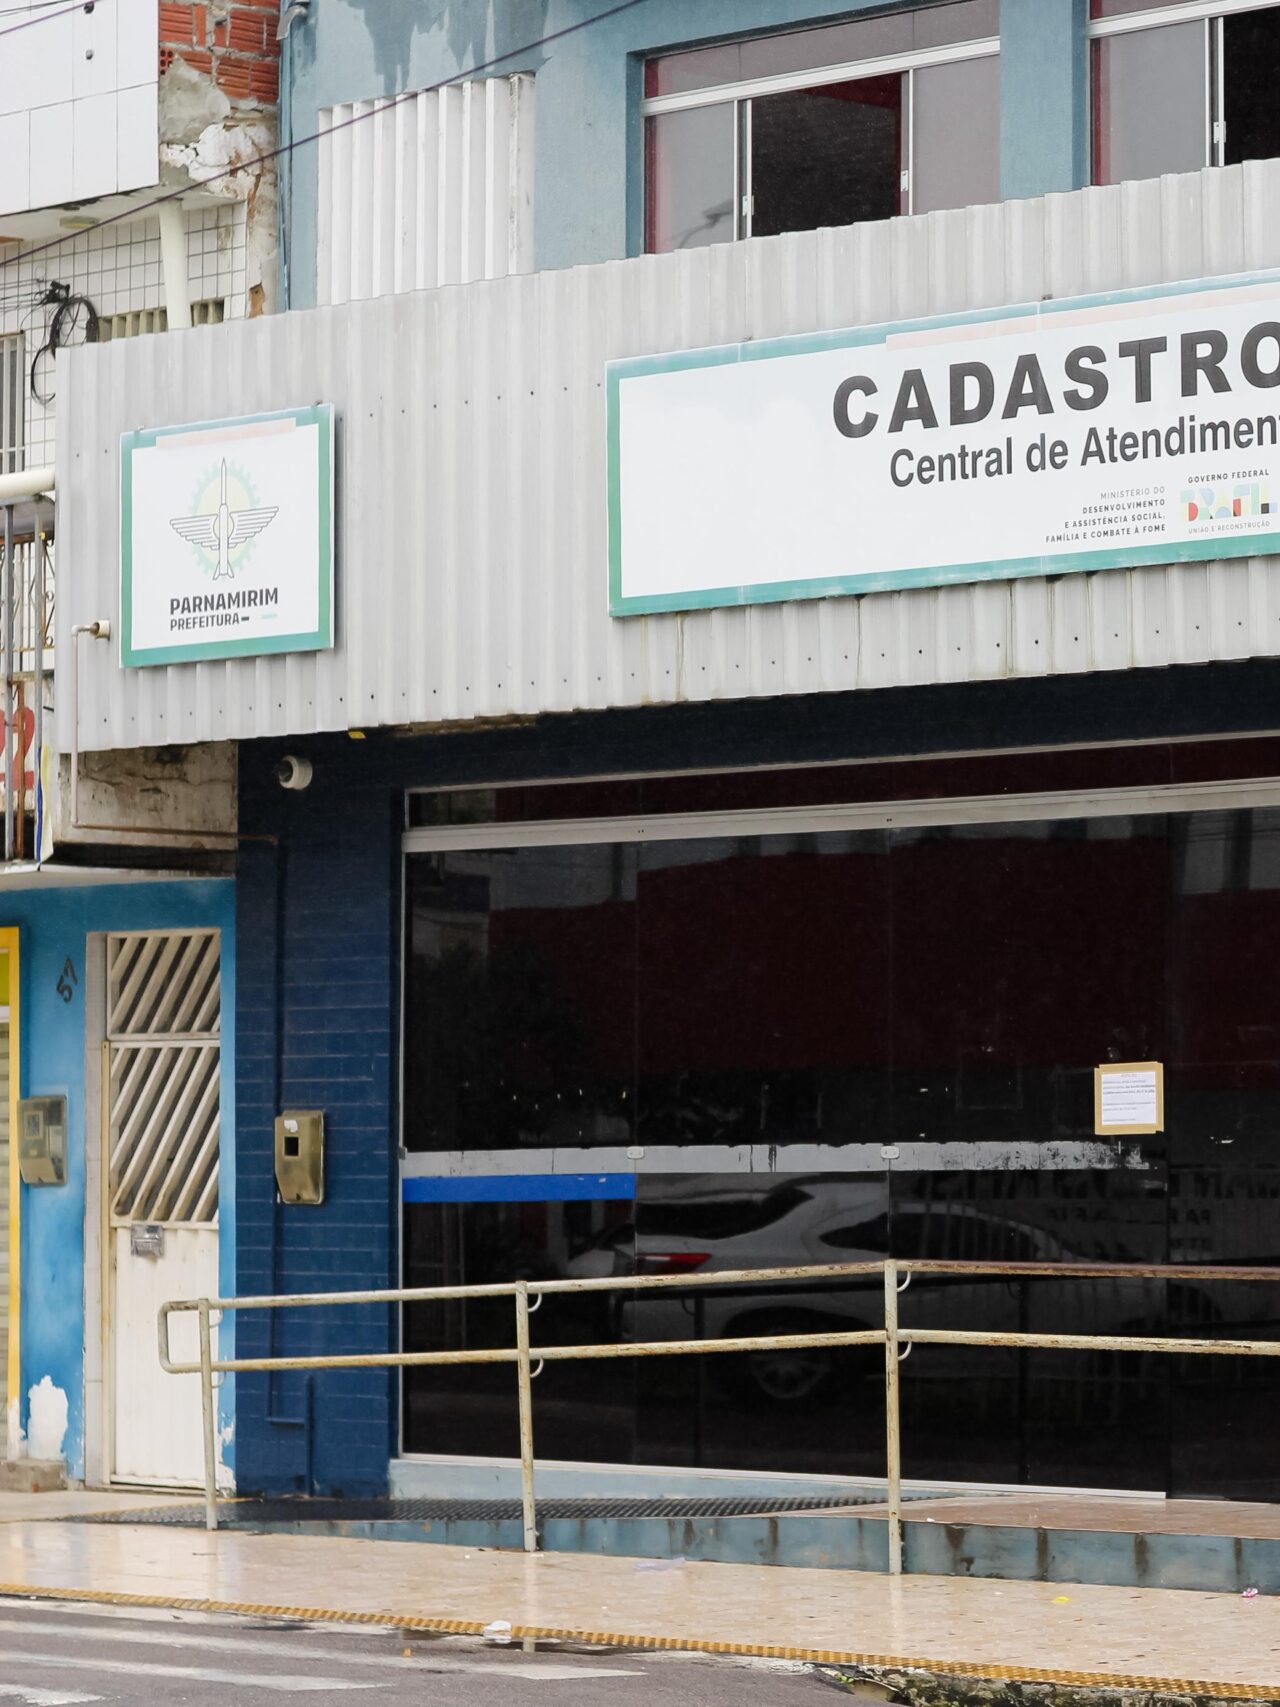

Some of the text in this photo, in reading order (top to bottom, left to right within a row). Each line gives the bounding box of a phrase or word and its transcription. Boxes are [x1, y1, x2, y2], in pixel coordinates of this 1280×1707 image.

[891, 437, 1013, 488] Central
[1026, 433, 1069, 473] de
[1188, 469, 1269, 483] GOVERNO FEDERAL
[1100, 486, 1166, 500] MINISTÉRIO DO
[1082, 499, 1166, 514] DESENVOLVIMENTO
[1064, 521, 1069, 529] E
[1072, 515, 1128, 528] ASSISTÊNCIA
[1188, 526, 1209, 534] UNIÃO
[1217, 520, 1271, 532] RECONSTRUÇÃO
[1046, 524, 1166, 543] FAMÍLIA E COMBATE À FOME
[170, 587, 278, 616] PARNAMIRIM
[170, 612, 240, 632] PREFEITURA
